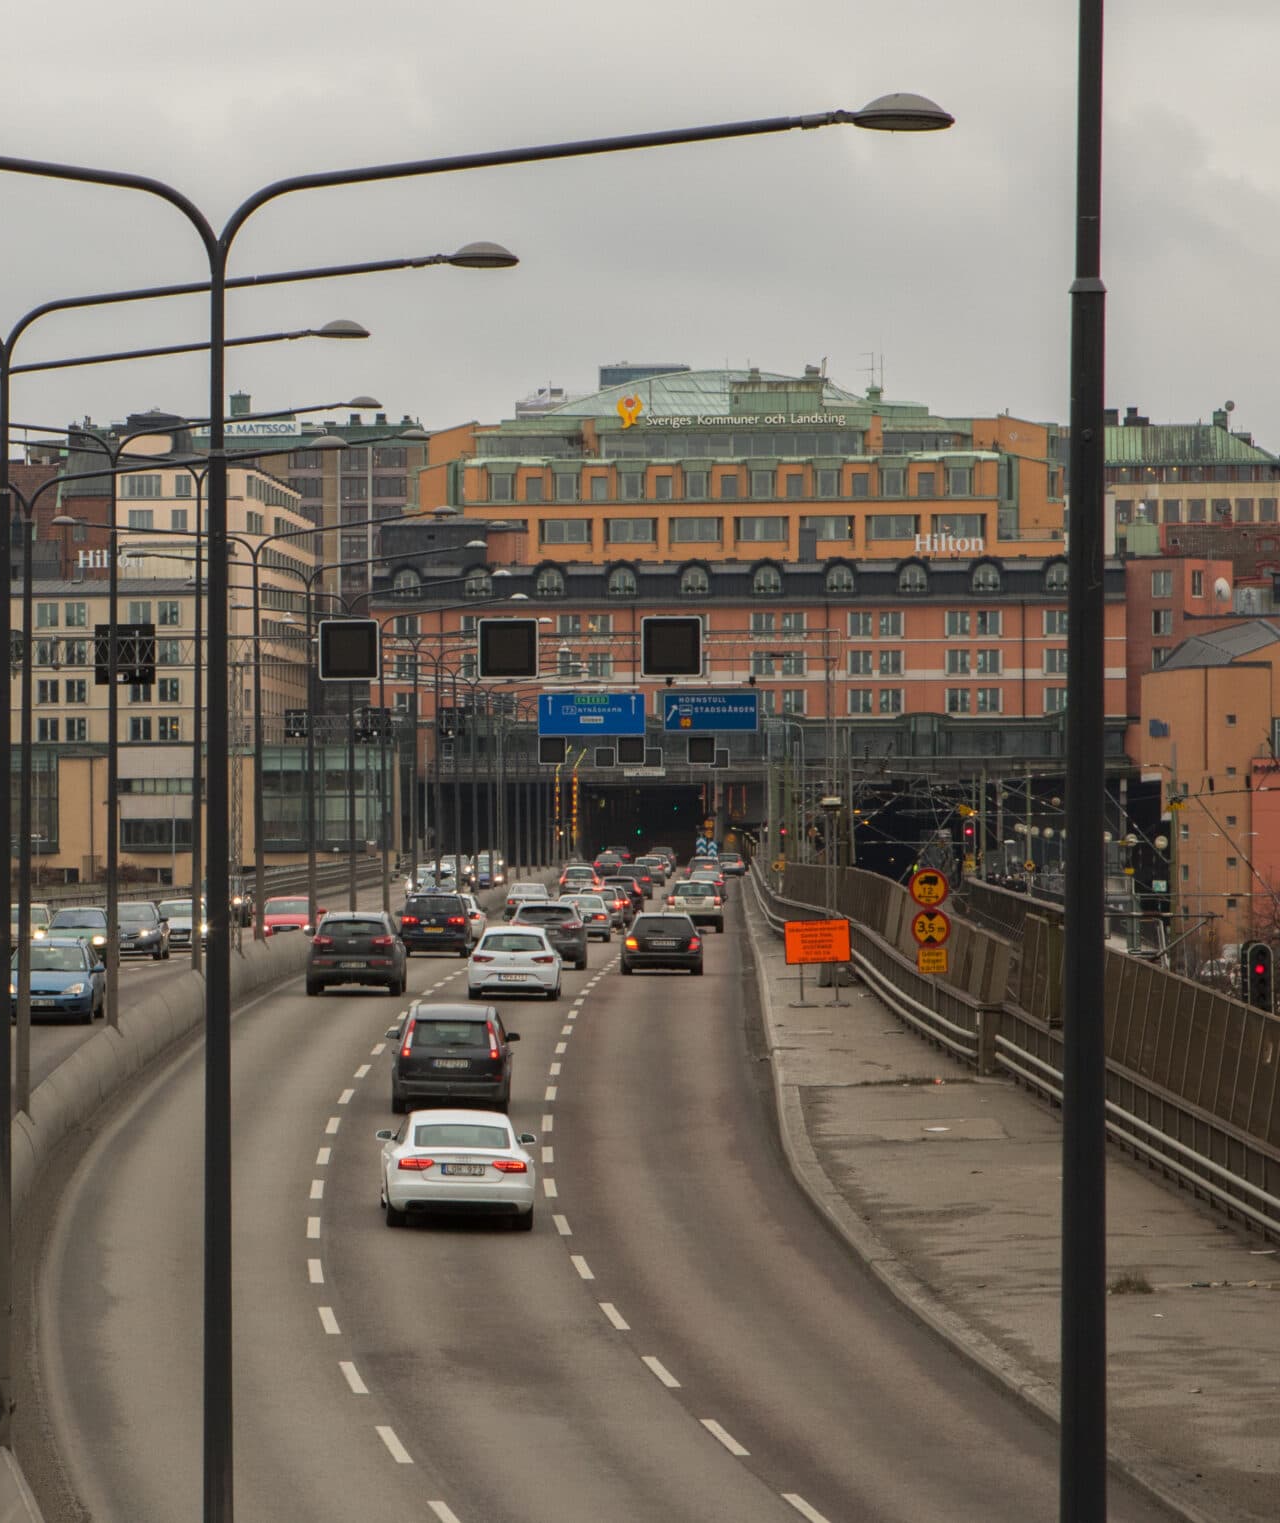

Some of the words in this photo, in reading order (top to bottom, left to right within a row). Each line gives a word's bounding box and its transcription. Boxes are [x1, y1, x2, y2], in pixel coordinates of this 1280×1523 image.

[646, 415, 692, 428] Sveriges
[697, 415, 760, 426] Kommuner
[764, 414, 785, 424] och
[791, 412, 846, 427] Landsting
[237, 423, 296, 433] MATTSSON
[915, 532, 984, 553] Hilton
[694, 705, 755, 713] STADSGÅRDEN
[923, 887, 933, 895] 12
[918, 921, 935, 935] 3,5
